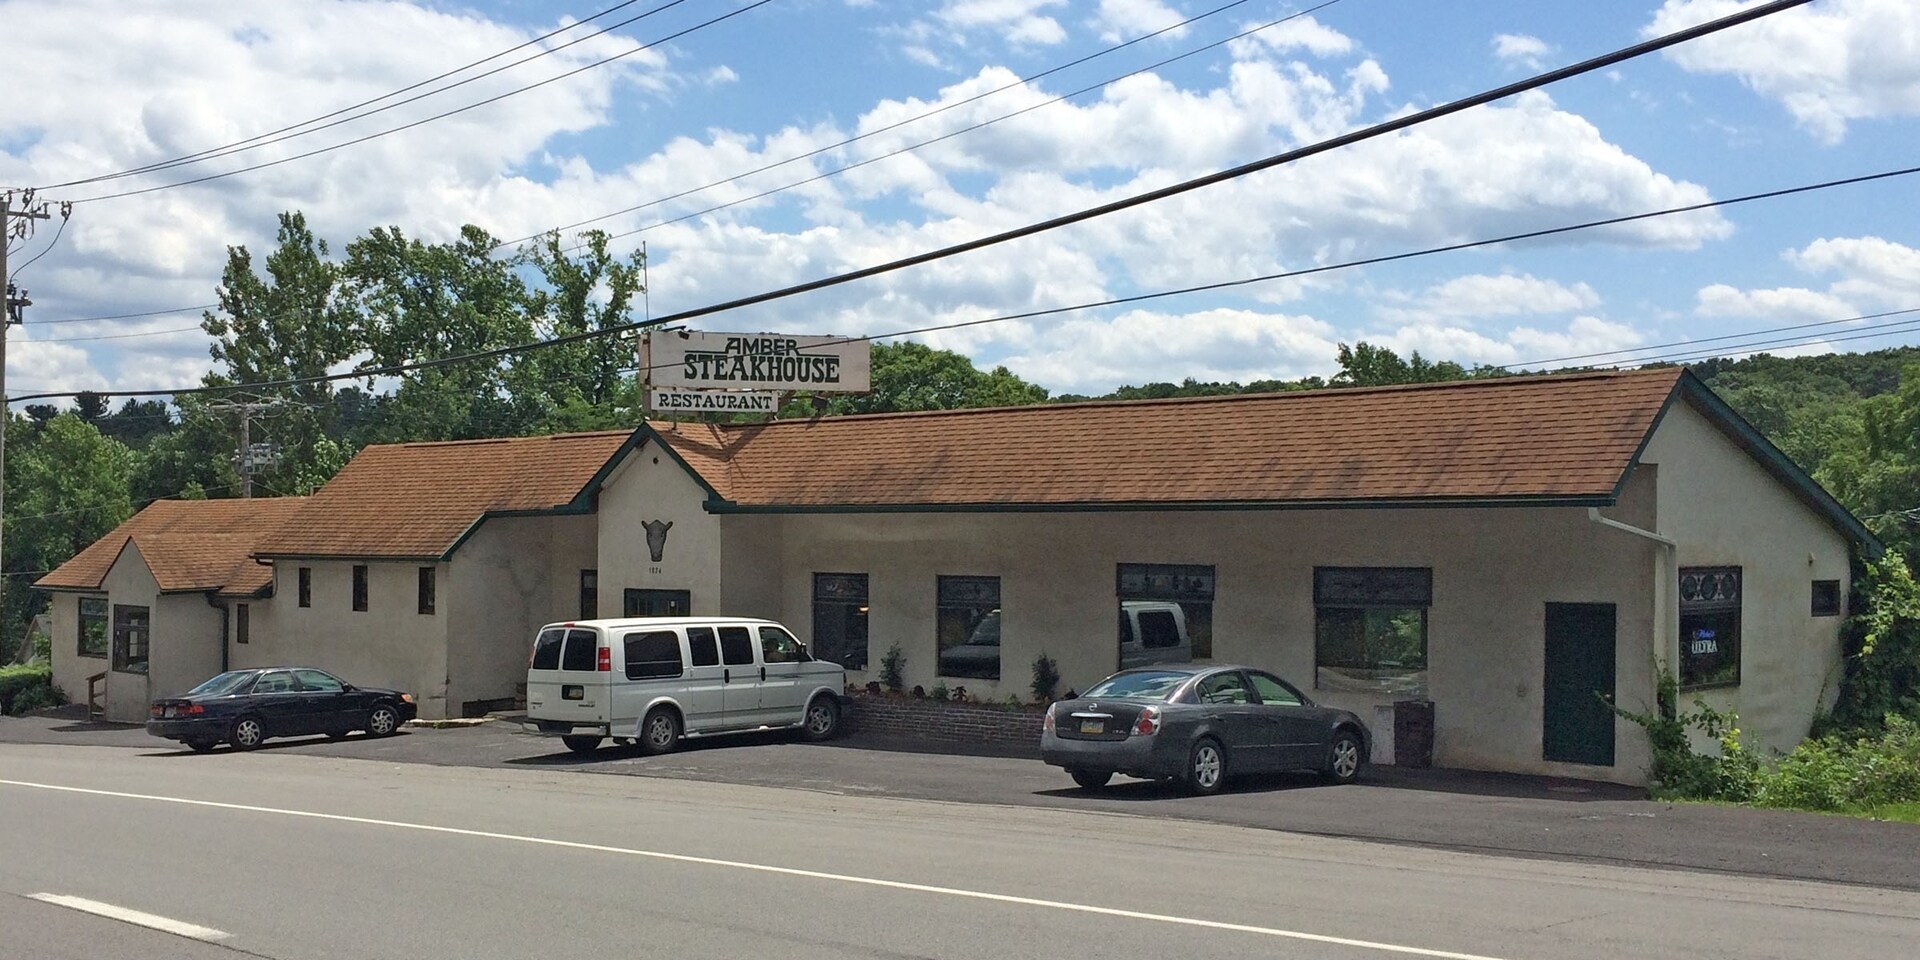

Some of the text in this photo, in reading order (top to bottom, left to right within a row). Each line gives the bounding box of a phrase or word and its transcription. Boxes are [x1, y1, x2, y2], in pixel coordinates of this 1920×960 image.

[725, 337, 800, 356] AMBER
[684, 353, 840, 383] STEAKHOUSE
[658, 393, 772, 410] RESTAURANT
[1691, 639, 1718, 654] ULTRA
